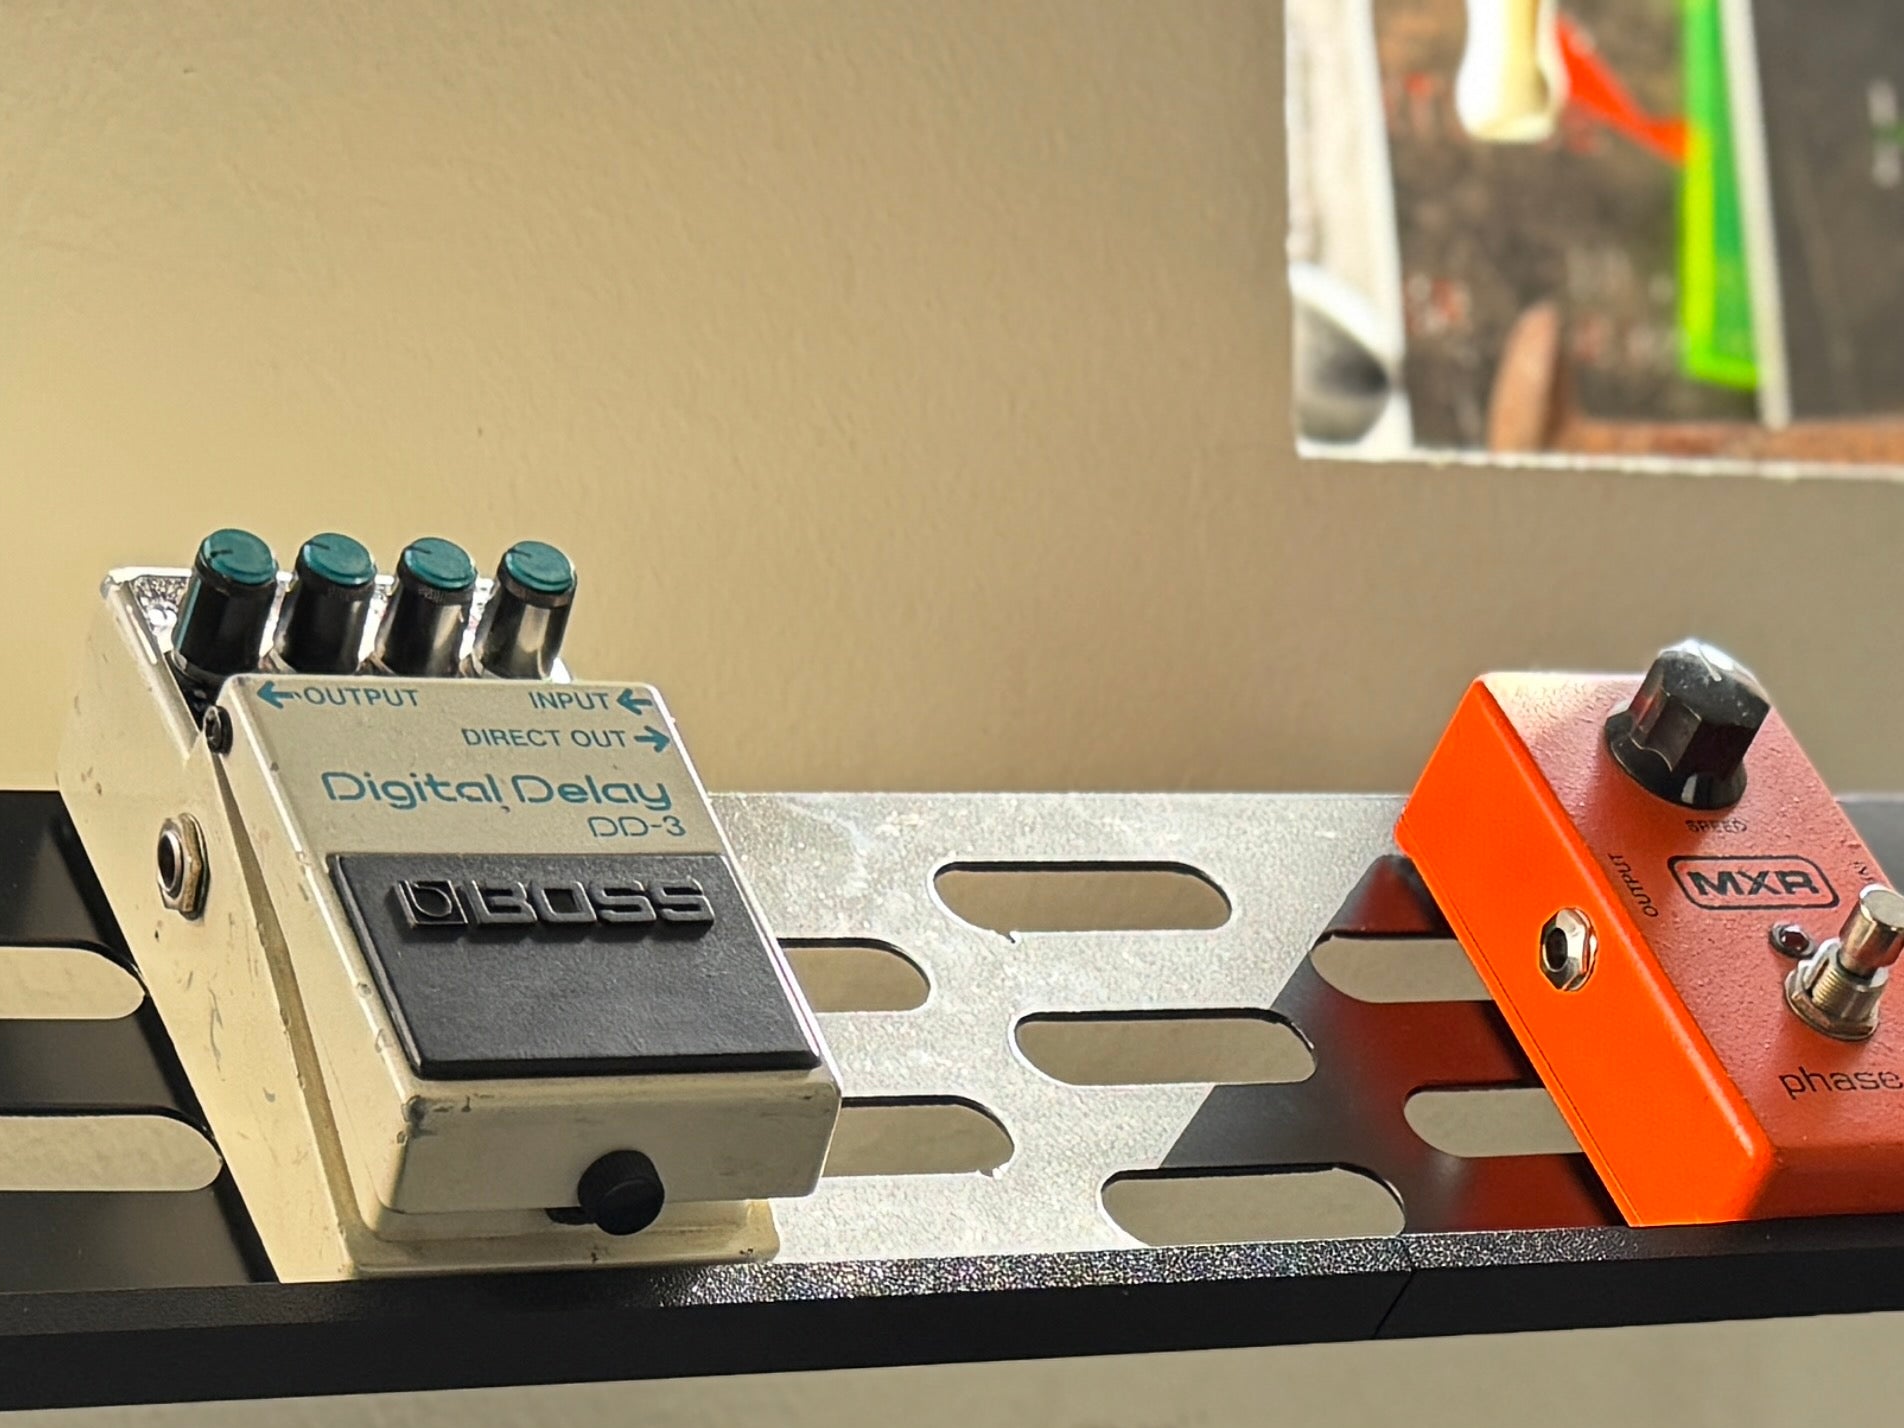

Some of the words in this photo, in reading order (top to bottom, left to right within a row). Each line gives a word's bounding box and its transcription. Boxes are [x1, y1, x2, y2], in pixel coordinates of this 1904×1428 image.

[303, 687, 420, 709] OUTPUT
[528, 691, 610, 712] INPUT
[462, 728, 562, 748] DIRECT
[570, 728, 628, 749] OUT
[320, 771, 504, 812] Digital
[511, 773, 673, 813] Delay
[588, 815, 687, 840] DD-3
[1684, 819, 1748, 834] SPEED
[1606, 851, 1659, 919] OUTPUT
[1686, 868, 1821, 897] MXR
[469, 877, 715, 928] BOSS
[1778, 1066, 1904, 1100] phase
